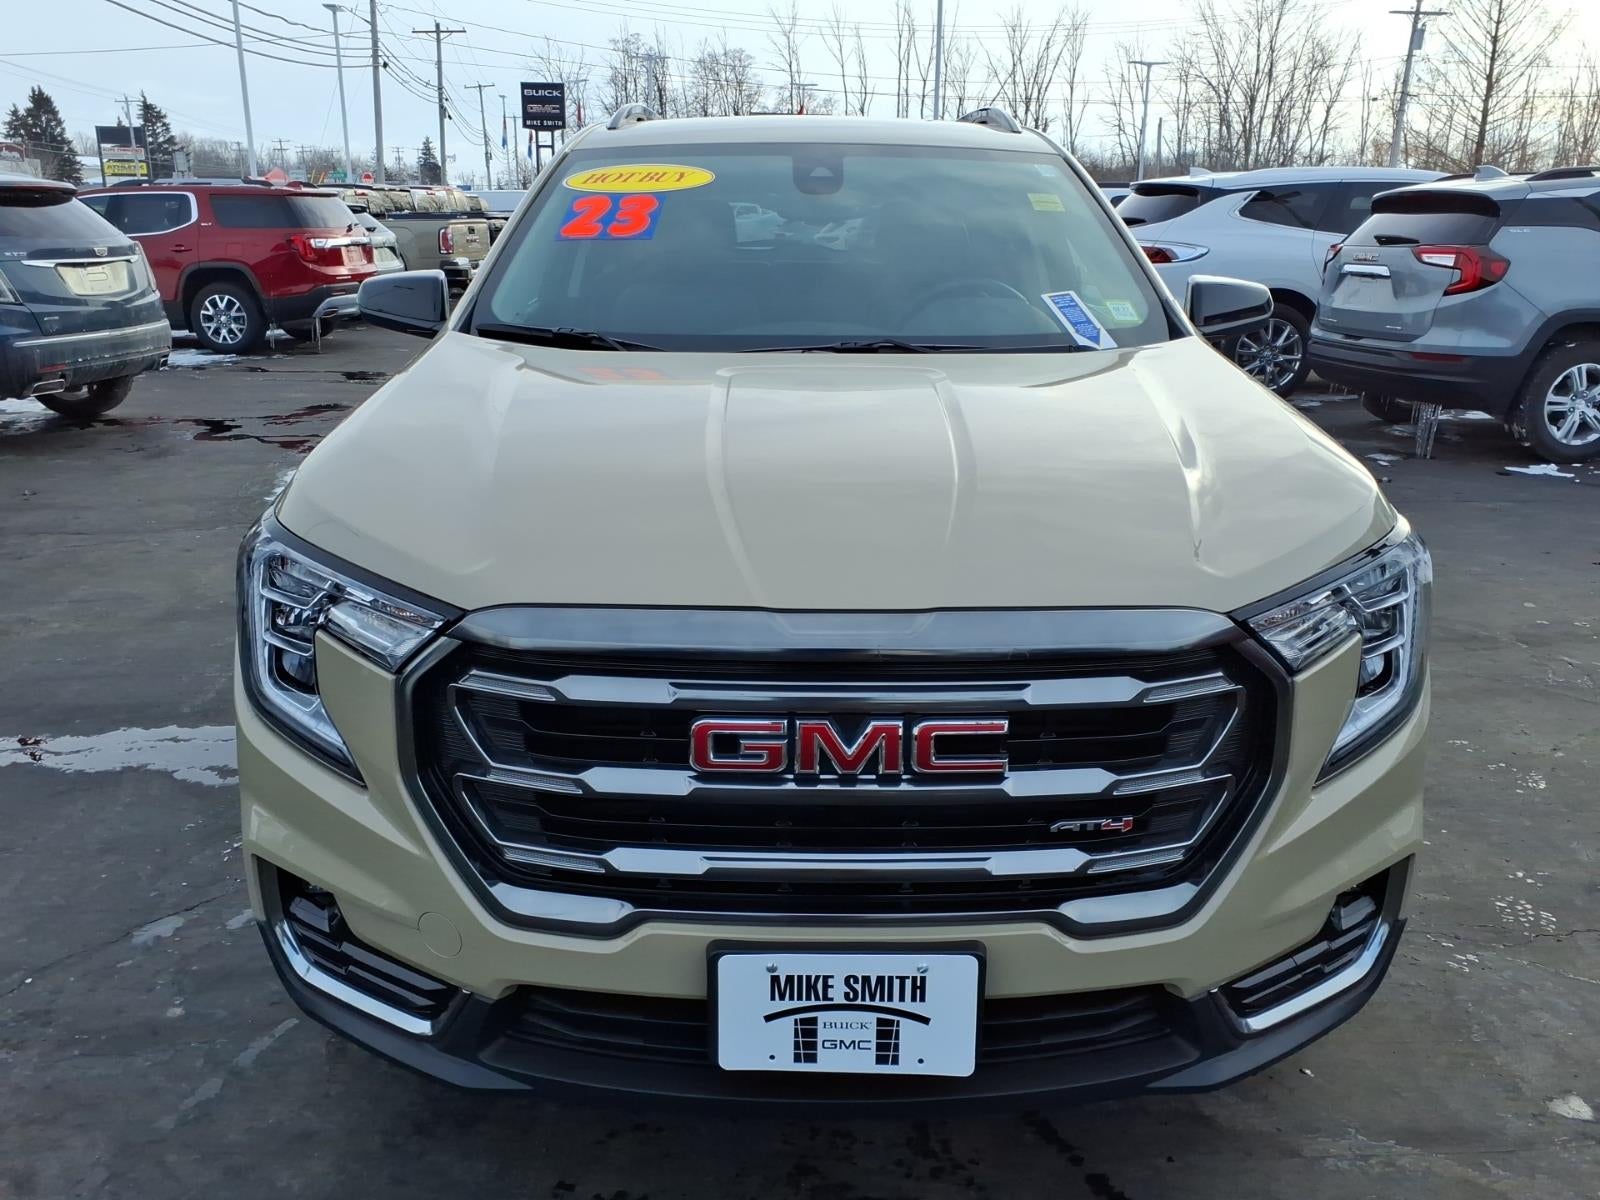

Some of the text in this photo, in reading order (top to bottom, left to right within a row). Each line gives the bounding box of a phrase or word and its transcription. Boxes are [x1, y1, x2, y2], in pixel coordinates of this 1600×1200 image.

[523, 88, 562, 97] BUICK
[526, 104, 561, 114] GMC
[543, 119, 563, 127] SMITH
[580, 171, 696, 186] HOT BUY
[559, 193, 660, 239] 23
[689, 718, 1009, 776] GMC
[1049, 816, 1133, 833] AT4
[769, 974, 927, 1003] MIKE SMITH
[822, 1021, 872, 1030] BUICK
[821, 1039, 872, 1051] GMC
